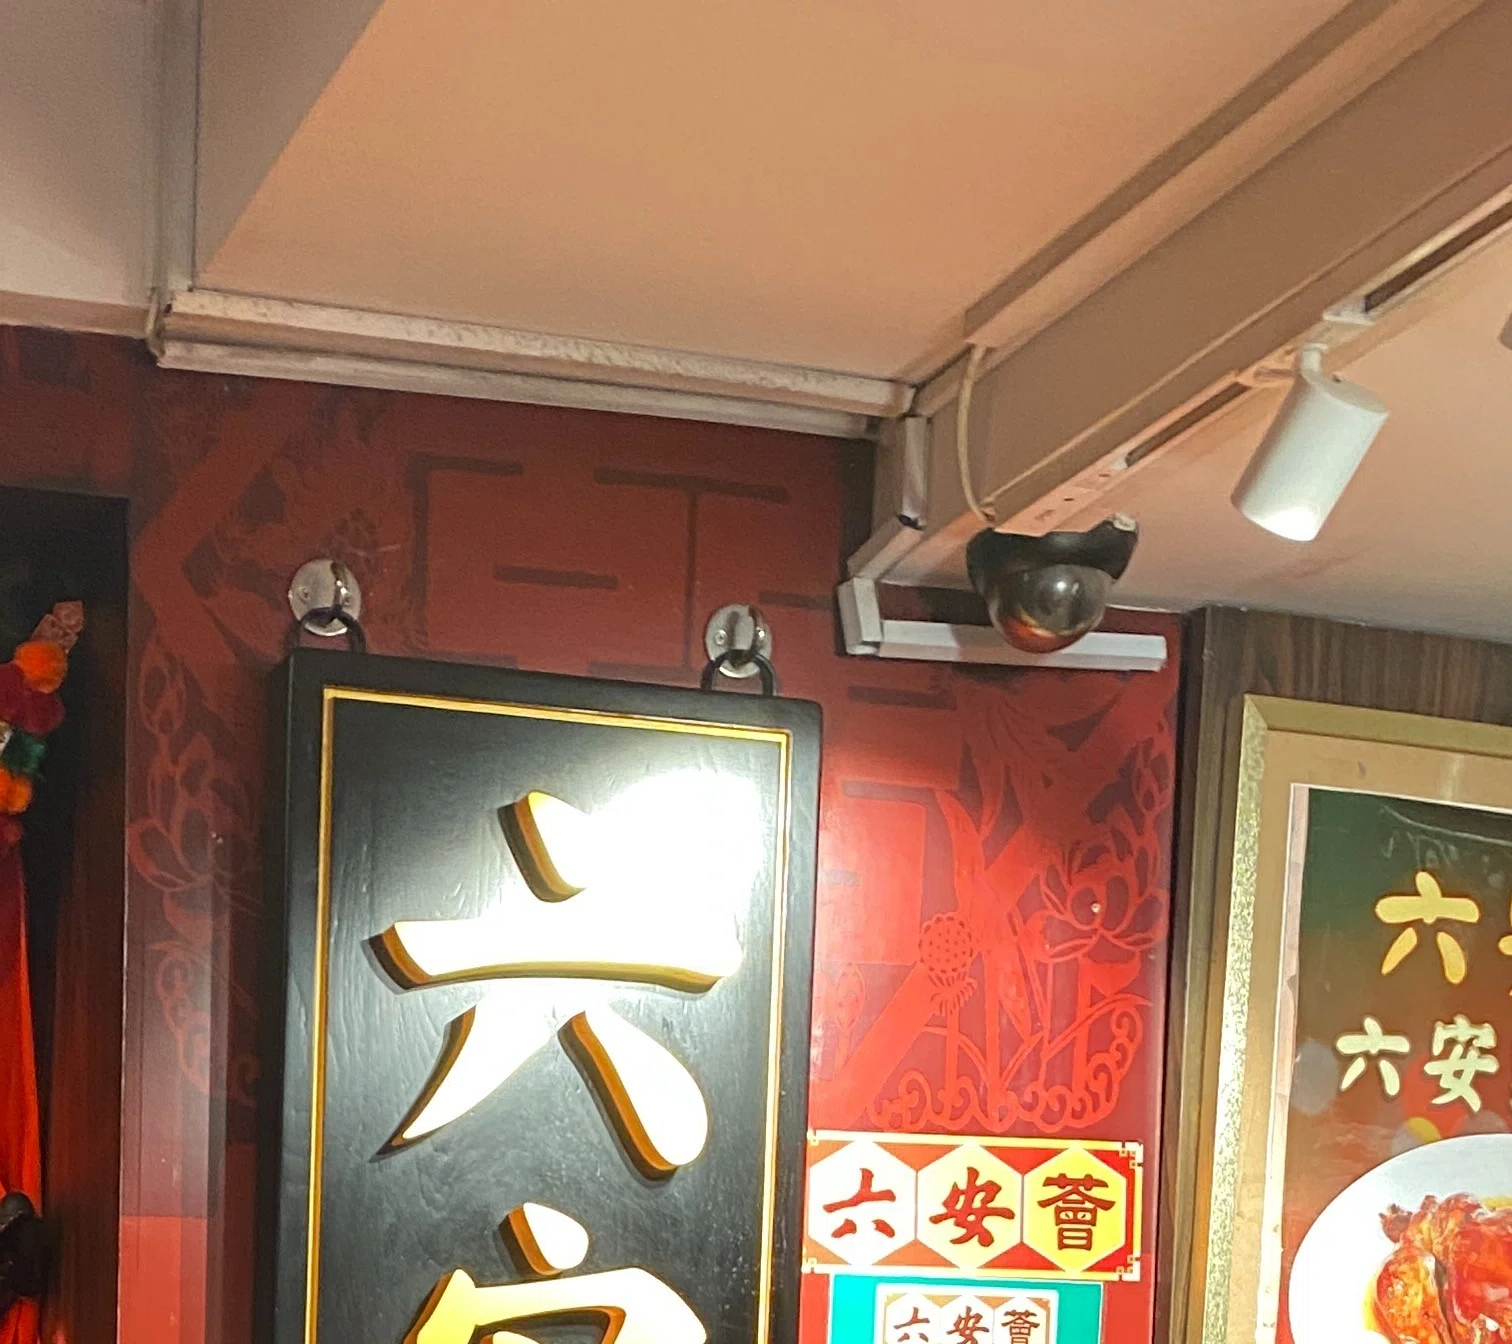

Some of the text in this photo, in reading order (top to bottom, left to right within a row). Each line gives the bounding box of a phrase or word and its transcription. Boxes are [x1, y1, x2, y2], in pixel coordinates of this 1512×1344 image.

[1375, 869, 1512, 996] 六
[1335, 1014, 1512, 1114] 六安
[823, 1166, 1116, 1252] 六安薈
